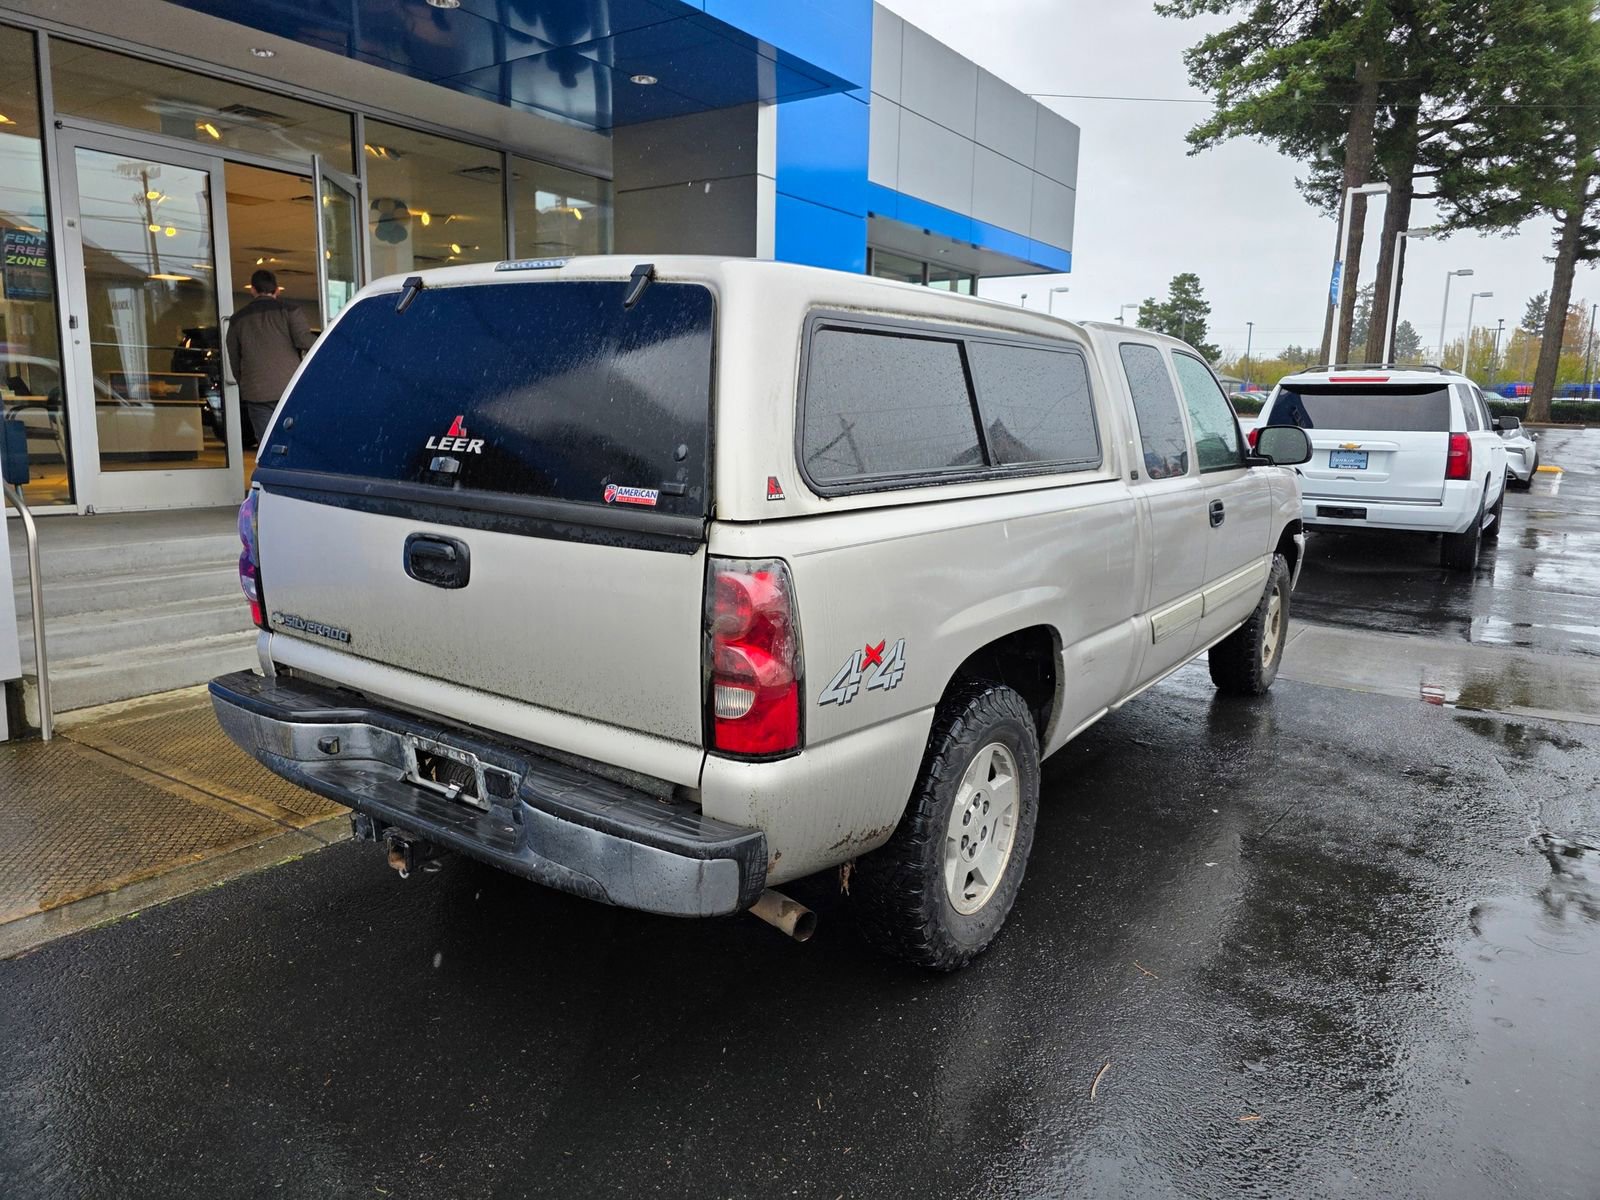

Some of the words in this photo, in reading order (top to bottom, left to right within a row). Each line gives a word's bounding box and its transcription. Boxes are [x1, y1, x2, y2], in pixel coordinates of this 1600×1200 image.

[4, 233, 47, 245] FENT
[5, 244, 46, 256] FREE
[5, 255, 47, 267] ZONE
[425, 435, 485, 454] LEER
[284, 614, 349, 642] SILVERADO
